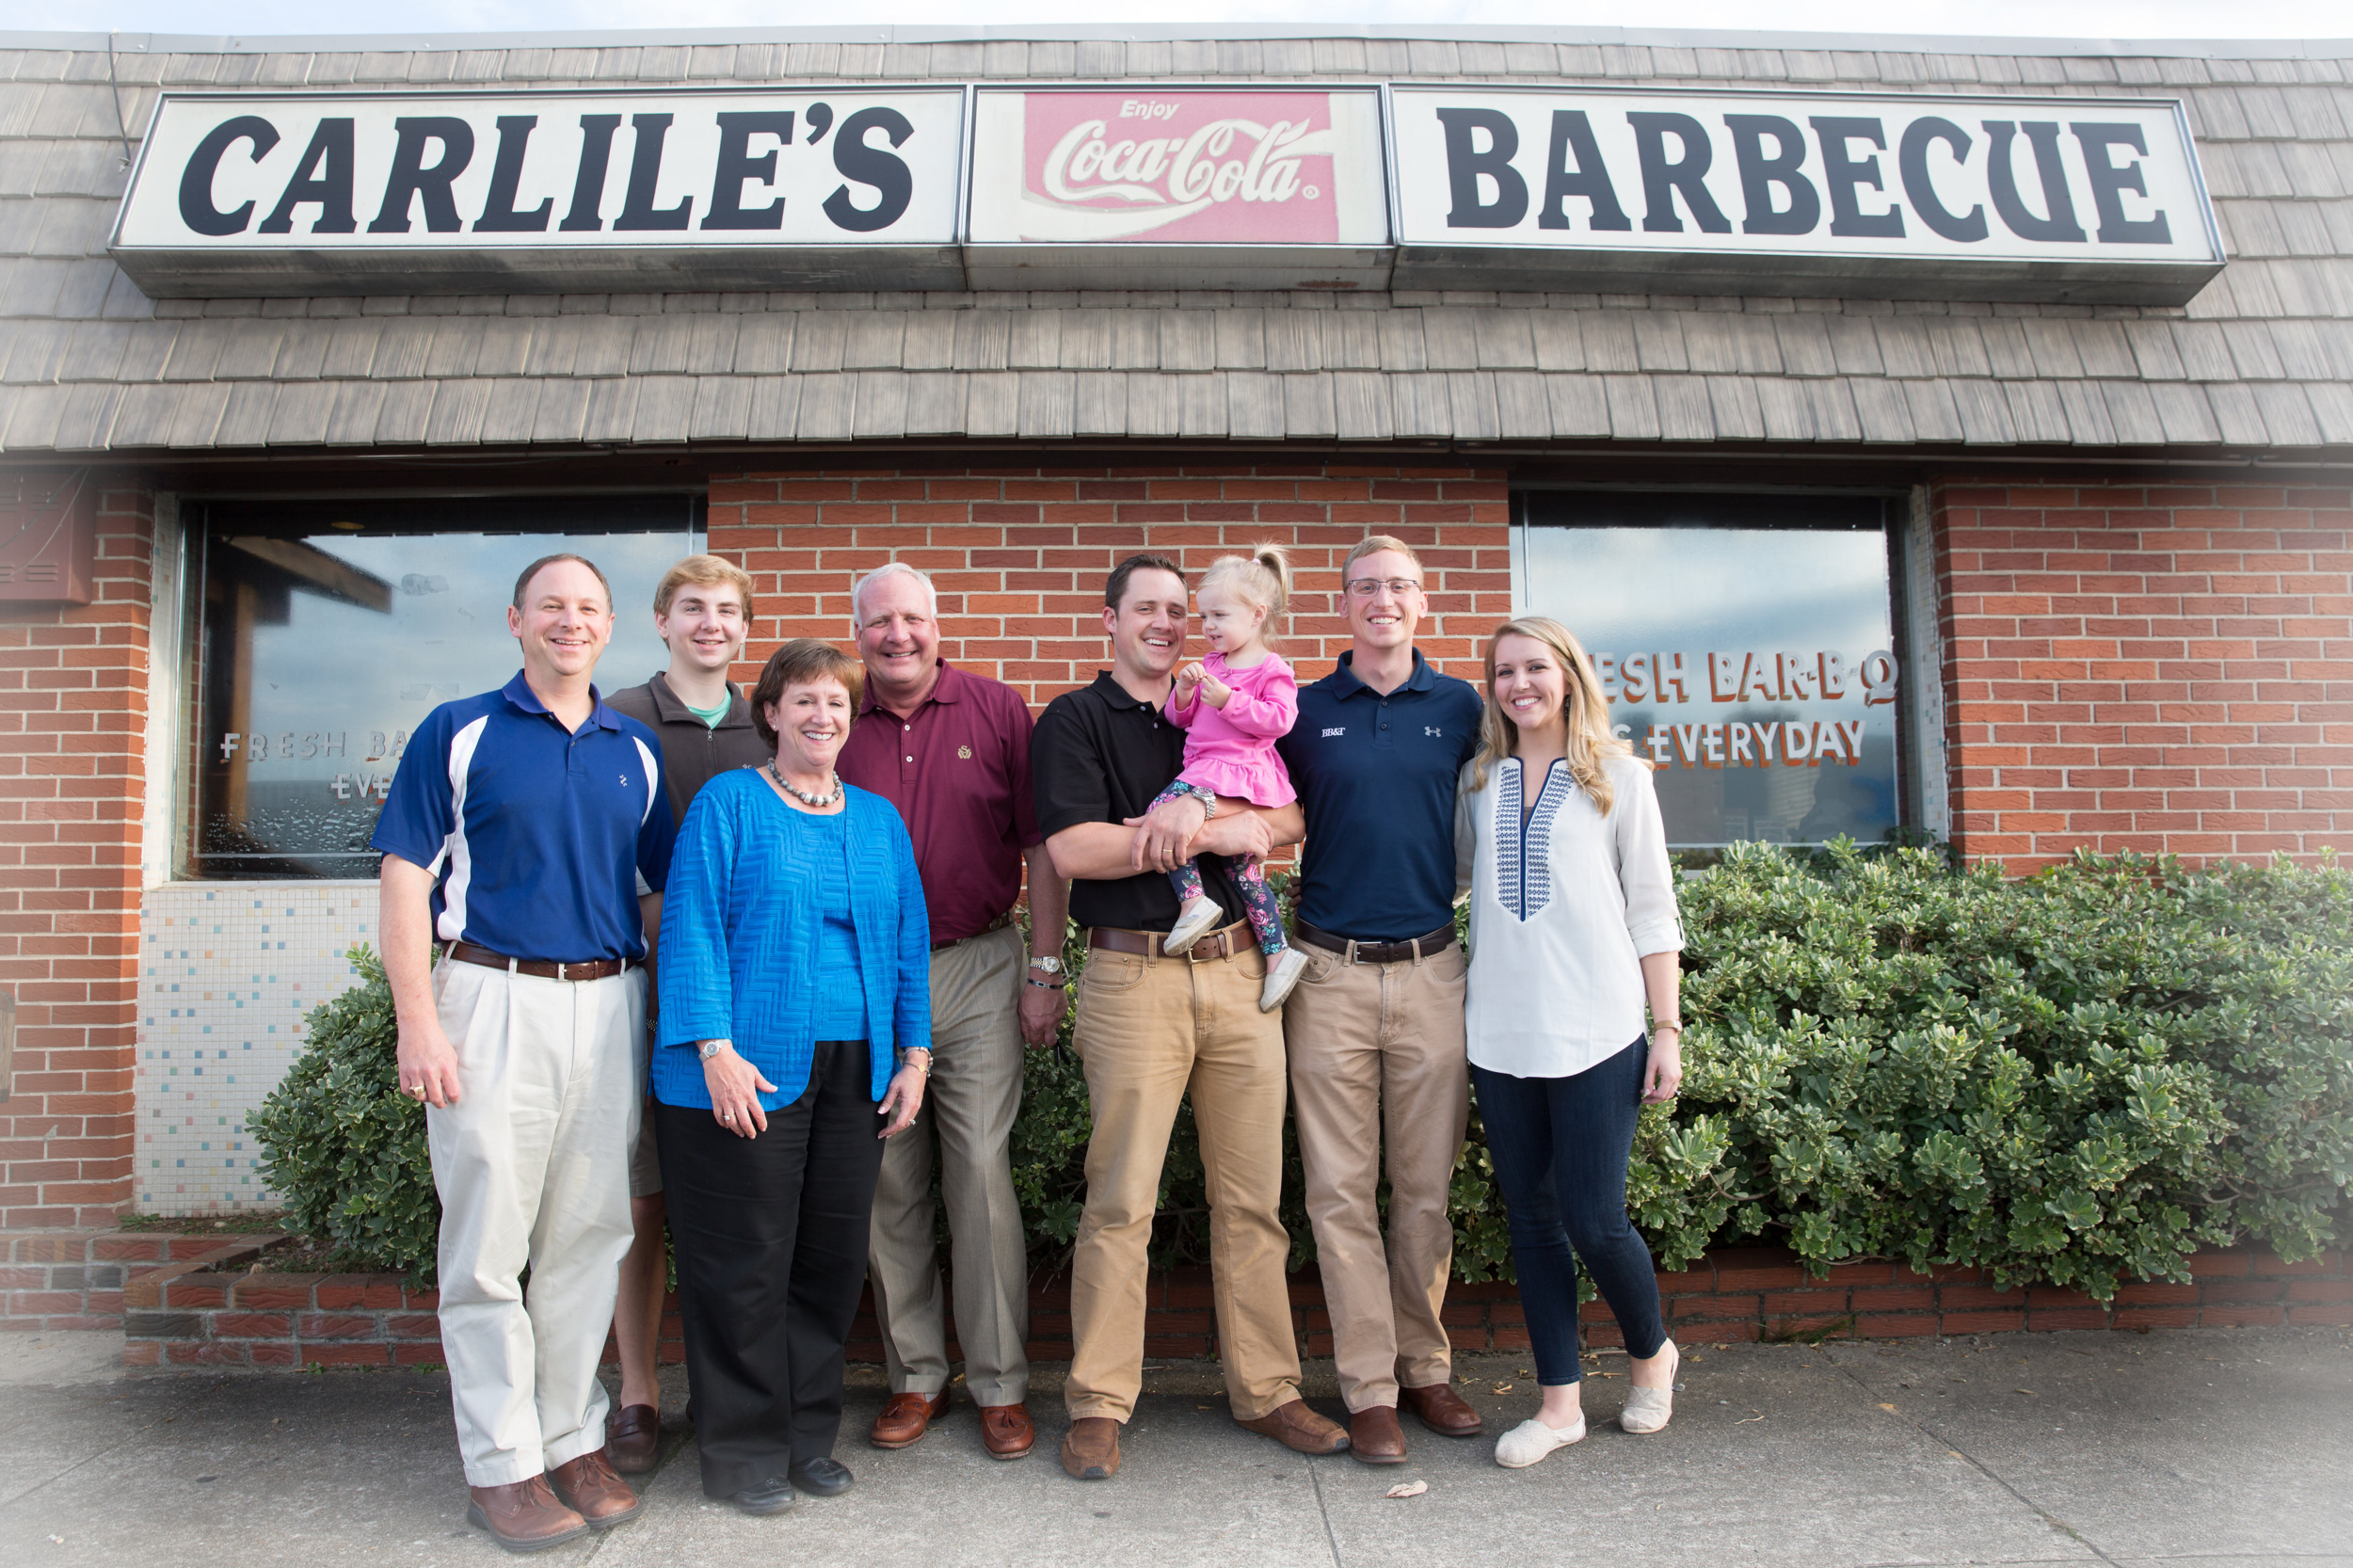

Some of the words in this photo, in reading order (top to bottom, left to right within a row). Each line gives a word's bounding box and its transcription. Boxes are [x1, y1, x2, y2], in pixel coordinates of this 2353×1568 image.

[1118, 99, 1180, 120] Enjoy
[179, 103, 915, 237] CARLILE'S
[1042, 118, 1311, 204] Coca-Cola
[1435, 107, 2172, 244] BARBECUE
[220, 731, 346, 760] FRESH
[1321, 727, 1346, 738] BB&T
[1642, 720, 1865, 770] EVERYDAY
